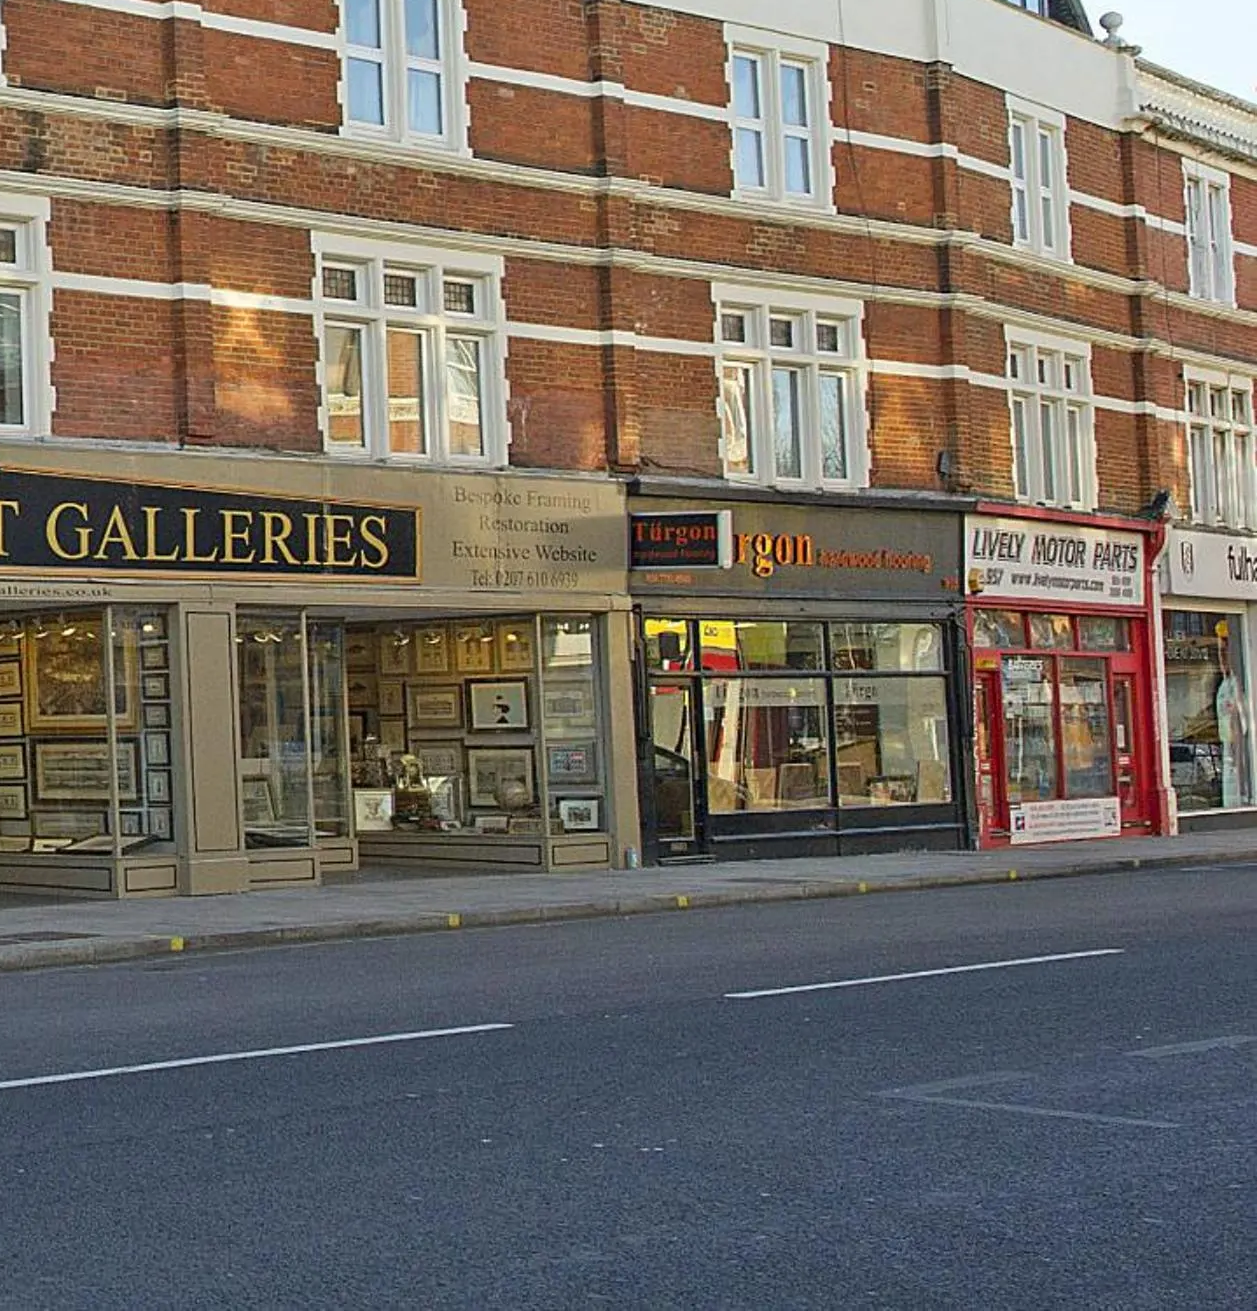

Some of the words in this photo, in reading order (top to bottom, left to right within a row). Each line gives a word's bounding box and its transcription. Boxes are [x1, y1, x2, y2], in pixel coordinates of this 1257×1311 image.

[454, 486, 521, 506] Bespoke
[527, 491, 591, 513] Framing
[46, 502, 389, 568] GALLERIES
[479, 515, 569, 534] Restoration
[452, 541, 530, 560] Extensive
[535, 544, 597, 562] Website
[734, 532, 815, 577] rgon
[972, 528, 1025, 562] LIVELY
[1031, 535, 1086, 568] MOTOR
[1094, 540, 1138, 572] PARTS
